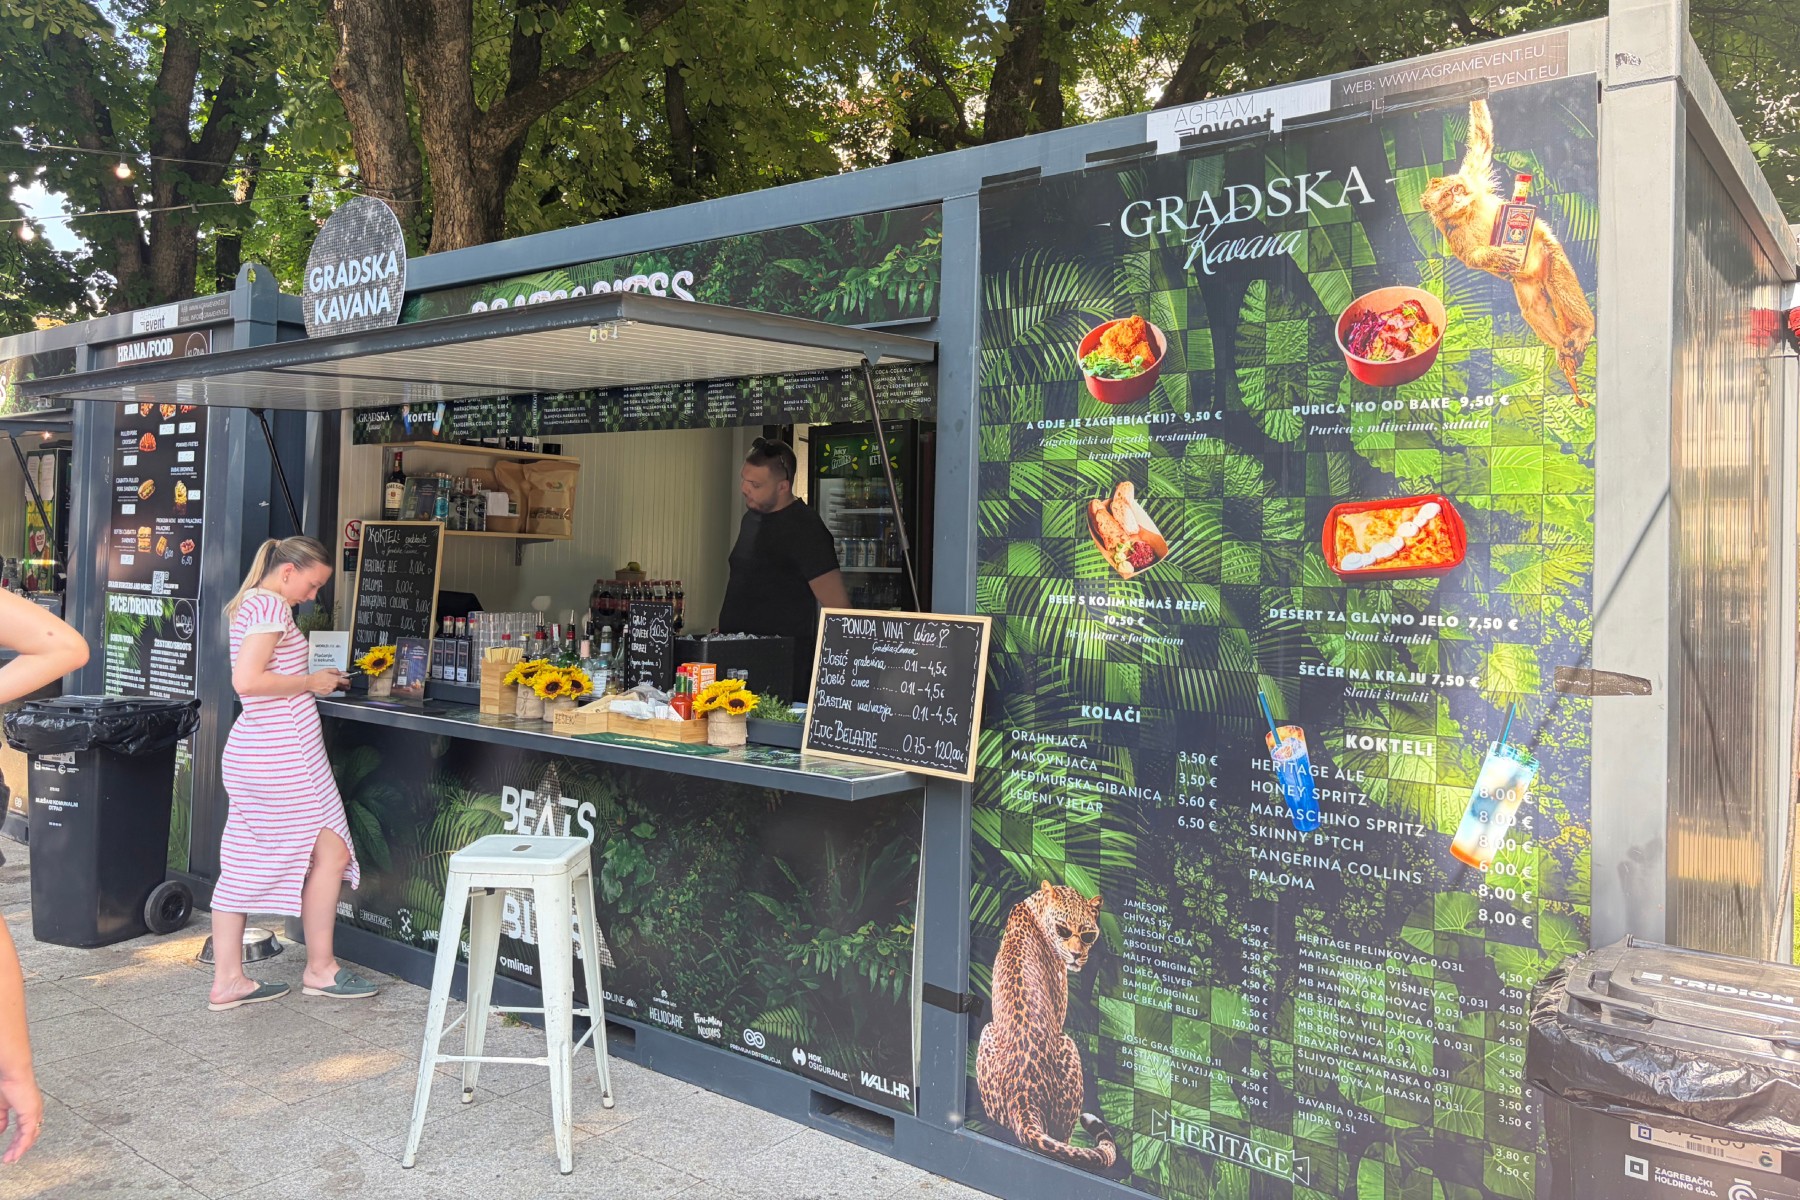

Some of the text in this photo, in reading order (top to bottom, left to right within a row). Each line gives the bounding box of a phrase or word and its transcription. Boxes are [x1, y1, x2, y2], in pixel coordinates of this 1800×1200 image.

[1343, 45, 1545, 95] WEB: WWW.AGRAMEVENT.EU
[1174, 95, 1254, 128] AGRAM
[1120, 166, 1375, 238] GRADSKA
[1182, 208, 1302, 275] Kavana
[309, 250, 399, 293] GRADSKA
[314, 286, 391, 326] KAVANA
[117, 338, 174, 363] HRANA/FOOD
[1292, 395, 1494, 416] PURICA OD BAKE 9,50
[1037, 411, 1211, 429] GDJE JE ZAGREB(AČKI)? 9,50
[1309, 418, 1490, 436] Purica salata
[1048, 594, 1208, 611] BEEF KOJIM NEMAŠ BEEF
[841, 617, 877, 637] PONUDA
[882, 620, 904, 640] VINA
[1103, 614, 1135, 627] 10,50
[1269, 608, 1503, 631] DESERT ZA GLAVNO JELO 7,50
[1344, 630, 1432, 646] Slani štrukli
[1298, 664, 1465, 688] ŠEĆER NA KRAJU 7,50
[817, 689, 852, 711] BASTIAN
[1343, 686, 1430, 704] Slatki štrukli
[1081, 704, 1141, 723] KOLAČI
[1011, 729, 1088, 750] ORAHNJAČA
[1345, 734, 1433, 757] KOKTELI
[1011, 749, 1098, 772] MAKOVNJAČA
[1178, 750, 1206, 766] 3,50
[1251, 757, 1365, 783] HERITAGE ALE
[1010, 768, 1162, 802] MEĐIMURSKA GIBANICA
[1178, 772, 1206, 787] 3,50
[1009, 789, 1103, 813] LEDENI VJETAR
[1178, 793, 1205, 808] 5,60
[1251, 780, 1368, 807] HONEY SPRITZ
[501, 785, 597, 845] BEATS
[1177, 815, 1205, 830] 6,50
[1250, 802, 1425, 838] MARASCHINO SPRITZ
[1250, 824, 1309, 844] SKINNY
[1478, 860, 1517, 876] 6,00
[1250, 846, 1516, 901] TANGERINA COLLINS 8,00
[1123, 898, 1166, 914] JAMESON
[1249, 868, 1516, 926] PALOMA 8,00
[1123, 912, 1156, 926] CHIVAS
[1123, 926, 1193, 947] JAMESON COLA
[1123, 939, 1163, 954] ABSOLUT
[1299, 933, 1427, 966] HERITAGE PELINKOVAC
[1299, 948, 1373, 971] MARASCHINO
[507, 956, 533, 976] mlinar
[1122, 952, 1199, 976] MALFY ORIGINAL
[1122, 965, 1193, 988] OLMECA SILVER
[1299, 963, 1455, 1002] MB INAMORANA VIŠNJEVAC
[1122, 978, 1200, 1004] BAMBU ORIGINAL
[1317, 980, 1428, 1012] MANNA ORAHOVAC
[1669, 975, 1794, 1004] TRIDION
[1122, 992, 1198, 1017] LUC BELAIR BLEU
[1317, 993, 1423, 1026] ŠIZIKA ŠLJIVOVICA
[649, 1006, 684, 1029] HELIOCARE
[1317, 1009, 1440, 1046] TRISKA VILIJAMOVKA
[1122, 1033, 1203, 1062] JOSIĆ GRAŠEVINA
[1317, 1024, 1384, 1048] BOROVNICA
[807, 1052, 822, 1064] HOK
[1121, 1046, 1215, 1079] BASTIAN MALVAZIJA
[1298, 1035, 1418, 1072] TRAVARICA MARASKA
[808, 1061, 849, 1082] OSIGURANJE
[1297, 1048, 1421, 1089] ŠLJIVOVICA MARASKA
[860, 1070, 910, 1101] WALL.HR
[1297, 1063, 1431, 1105] VILIJAMOVKA MARASKA
[1298, 1110, 1357, 1134] HIDRA 0,5L
[1298, 1095, 1520, 1162] BAVARIA 0,25L 3,80
[1170, 1118, 1290, 1175] HERITAGE
[1654, 1166, 1714, 1189] ZAGREBAČKI
[1654, 1174, 1719, 1198] HOLDING d.o.o.
